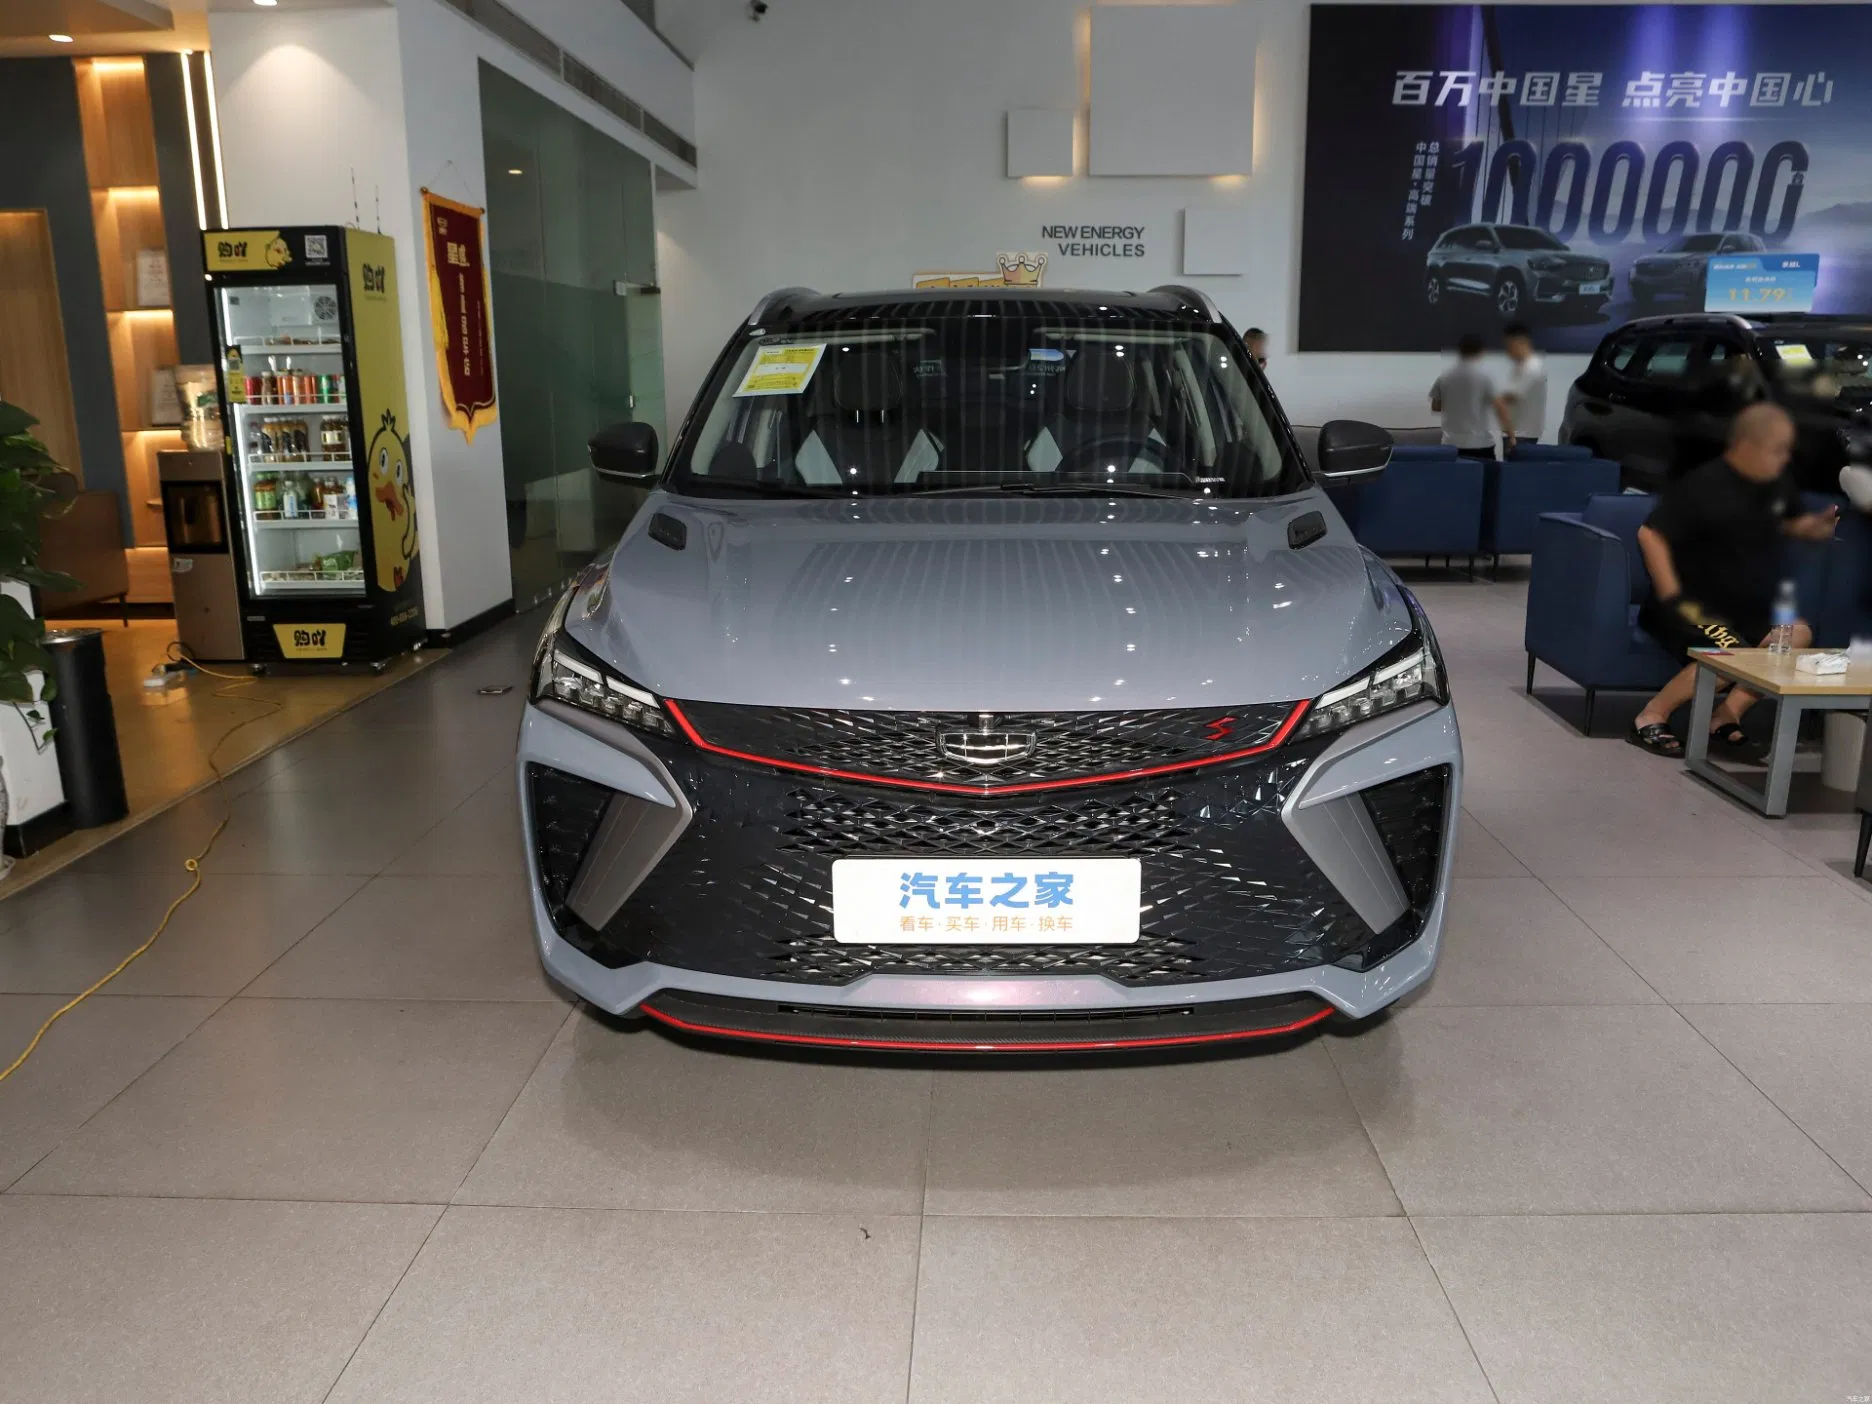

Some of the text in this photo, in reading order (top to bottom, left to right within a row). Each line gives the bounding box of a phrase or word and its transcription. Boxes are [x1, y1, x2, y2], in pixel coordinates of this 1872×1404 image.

[1392, 71, 1835, 108] 百万中国星 点亮中国心
[1042, 225, 1145, 240] NEW ENERGY
[1058, 243, 1145, 257] VEHICLES
[899, 871, 1074, 909] 汽车之家
[899, 915, 1073, 932] 看车·买车·用车·换车
